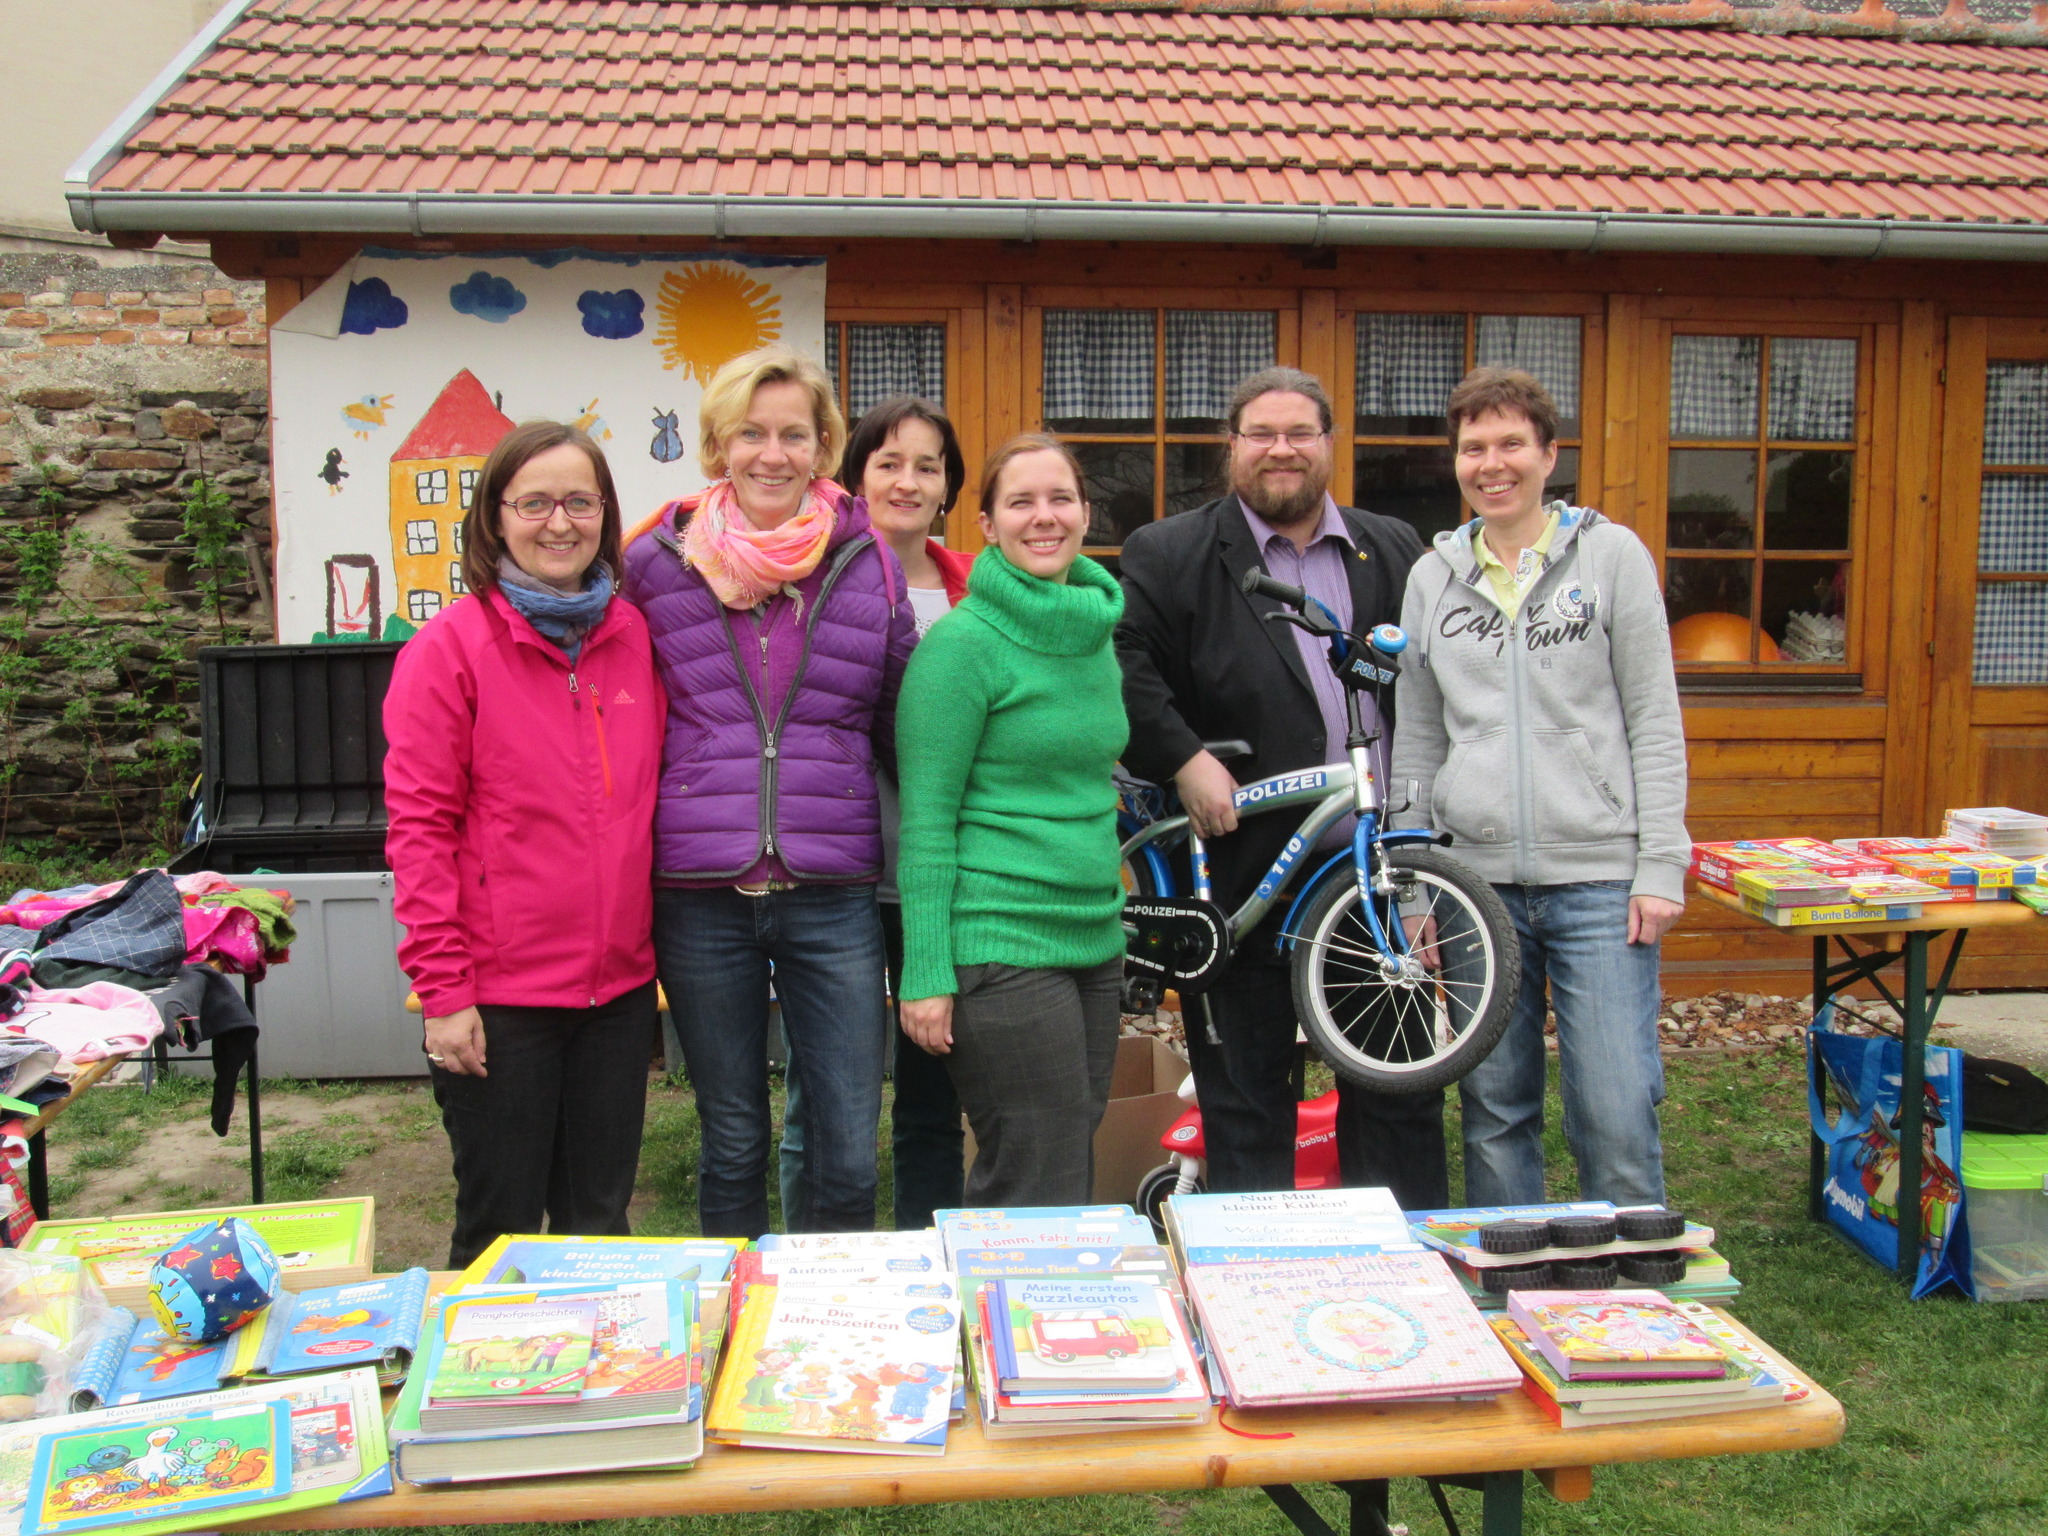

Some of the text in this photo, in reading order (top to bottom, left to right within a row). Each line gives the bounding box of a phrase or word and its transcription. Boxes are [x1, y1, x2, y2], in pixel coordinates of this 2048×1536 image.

[1351, 658, 1395, 685] POLIZEI
[1235, 772, 1323, 807] POLIZEI
[1272, 836, 1303, 876] 110
[1133, 904, 1176, 917] POLIZEI
[1811, 910, 1841, 921] Bunte
[1844, 909, 1883, 919] Ballone
[1240, 1192, 1324, 1202] Nur Mut,
[1222, 1200, 1348, 1212] kleine Küken!
[1225, 1225, 1279, 1233] Weißt
[981, 1233, 1112, 1249] Komm, fahr mit!
[563, 1252, 595, 1261] Bei
[637, 1252, 661, 1261] im
[574, 1261, 640, 1270] Hexen-
[788, 1266, 838, 1275] Autos
[969, 1265, 1079, 1275] Wenn kleine Tiere
[540, 1269, 664, 1281] kindergarten
[1025, 1284, 1132, 1293] Meine ersten
[1316, 1278, 1408, 1290] Geheimnis
[1021, 1292, 1140, 1304] Puzzleautos
[471, 1307, 583, 1320] Ponyhofgeschichten
[827, 1308, 854, 1319] Die
[778, 1313, 900, 1331] Jahreszeiten
[340, 1371, 363, 1382] 3+
[104, 1398, 208, 1420] Ravensburger
[208, 1388, 255, 1404] Puzzle
